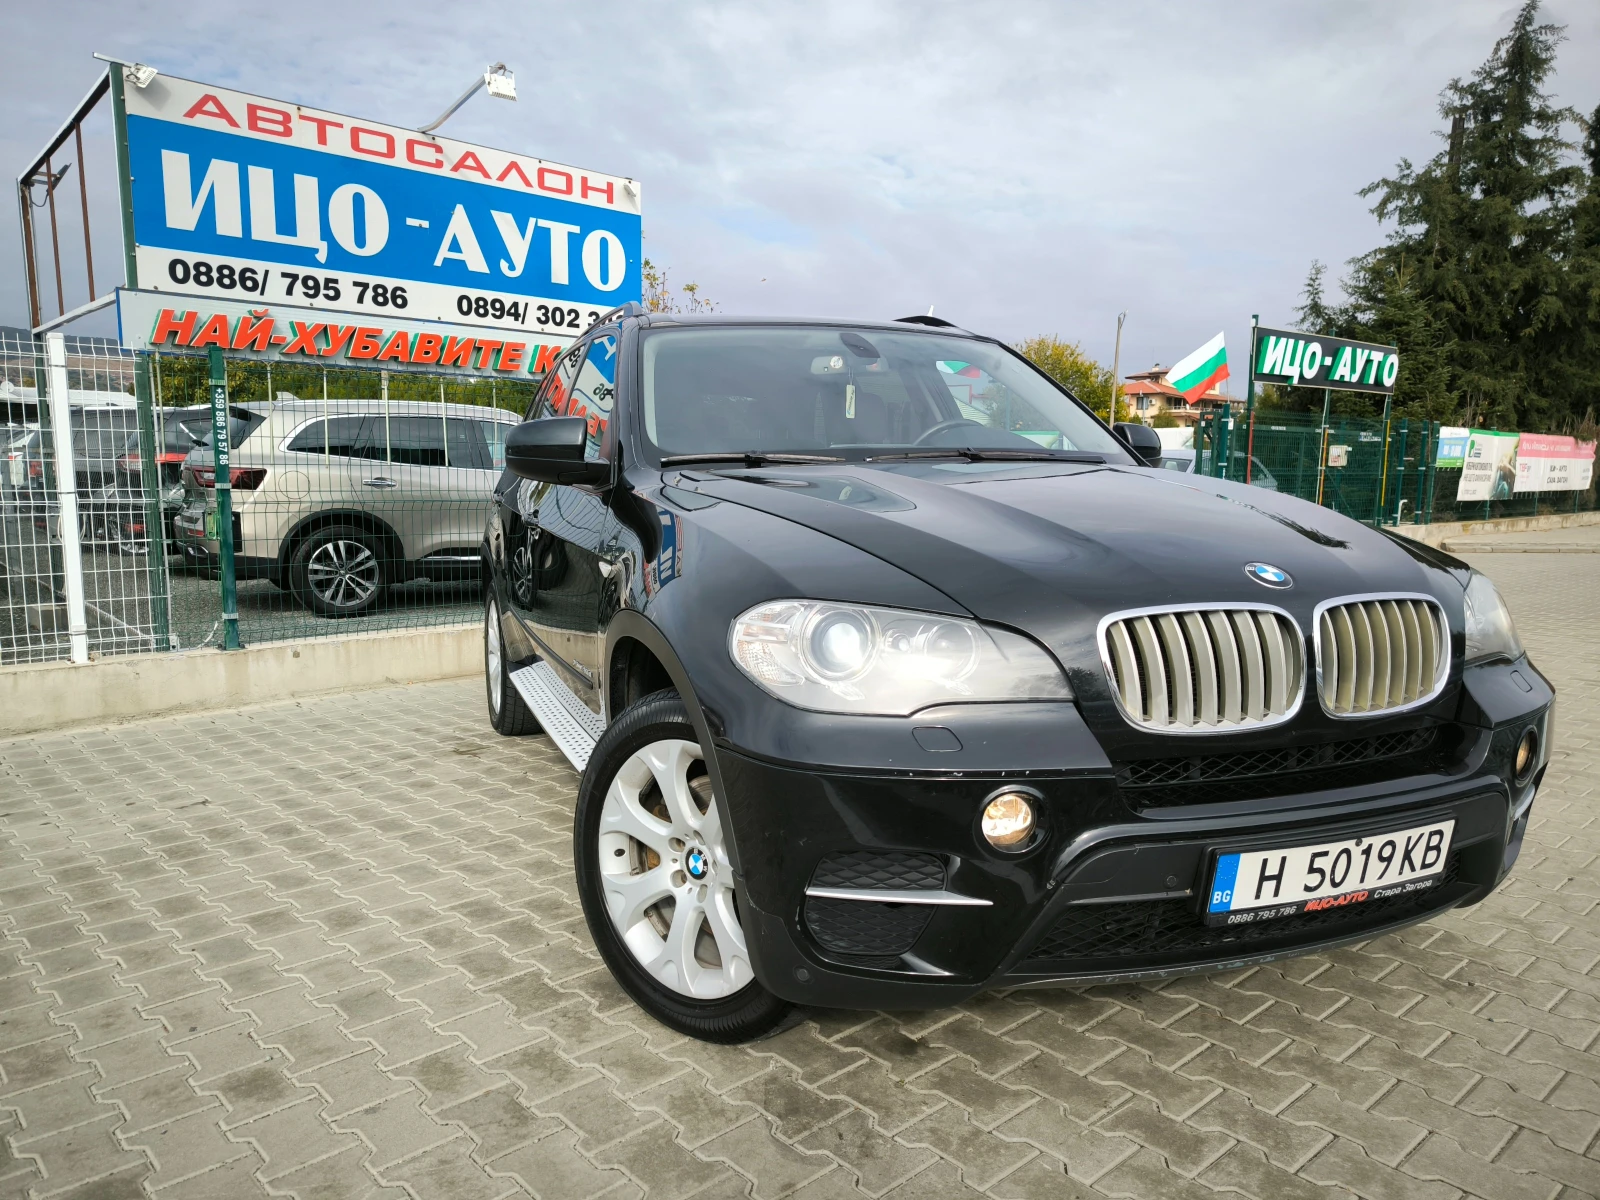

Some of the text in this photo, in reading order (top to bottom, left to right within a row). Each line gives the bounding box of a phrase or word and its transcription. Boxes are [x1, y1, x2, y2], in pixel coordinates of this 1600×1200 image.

[183, 93, 614, 205] АВТОСАЛОН
[280, 272, 341, 301] 795
[352, 281, 408, 309] 786
[536, 305, 580, 328] 302
[215, 388, 228, 464] +359 886 79 57 86
[1213, 890, 1232, 904] BG
[1227, 912, 1254, 925] 0886
[1256, 909, 1276, 921] 795
[1278, 906, 1298, 918] 786
